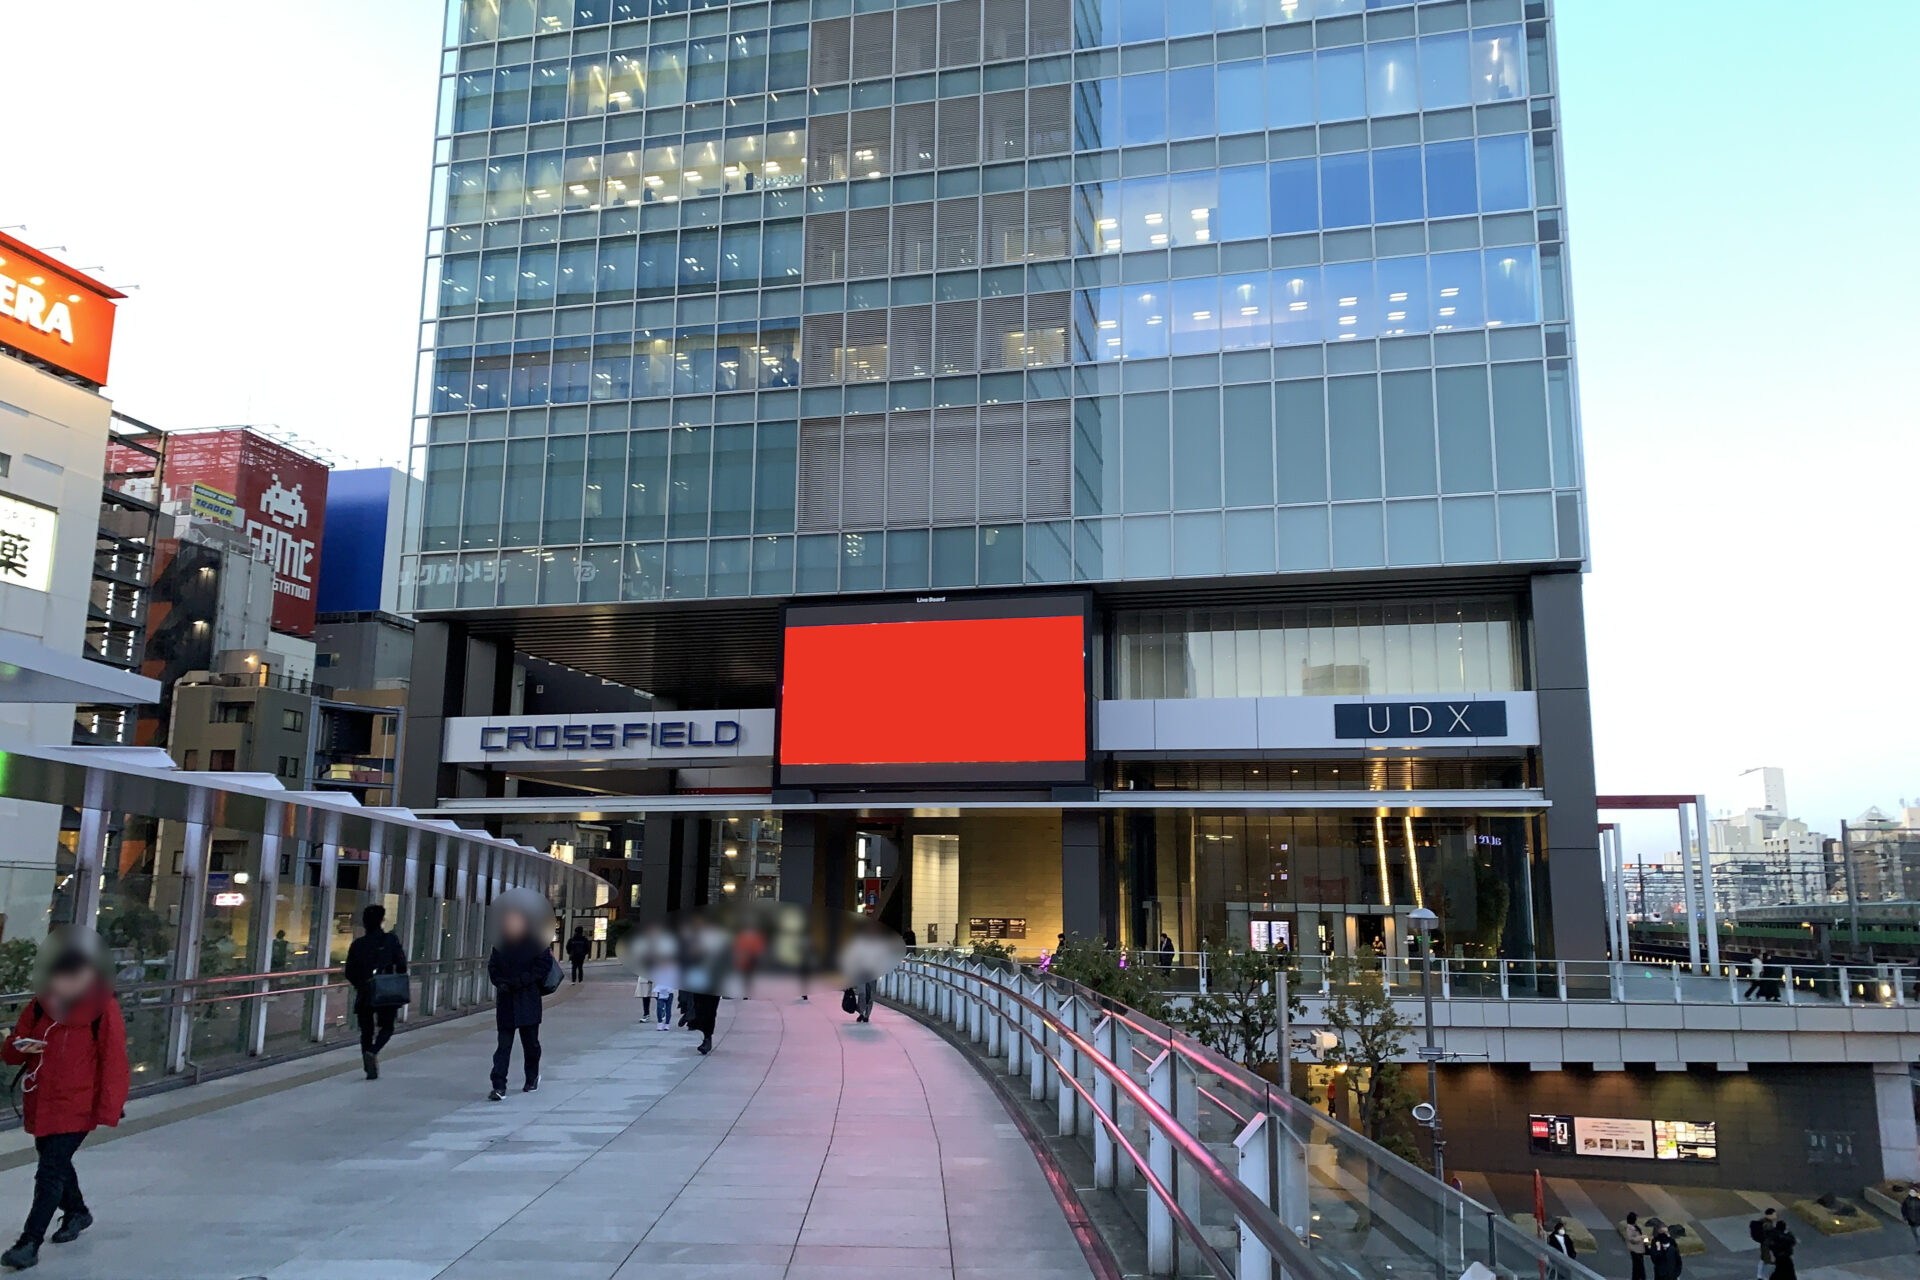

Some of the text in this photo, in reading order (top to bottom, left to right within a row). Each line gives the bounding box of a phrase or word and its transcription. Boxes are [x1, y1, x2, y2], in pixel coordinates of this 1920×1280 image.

[0, 273, 74, 344] ERA
[246, 519, 315, 583] GAME
[273, 577, 311, 601] STATION
[1368, 704, 1472, 734] UDX
[480, 720, 740, 751] CROSSFIELD
